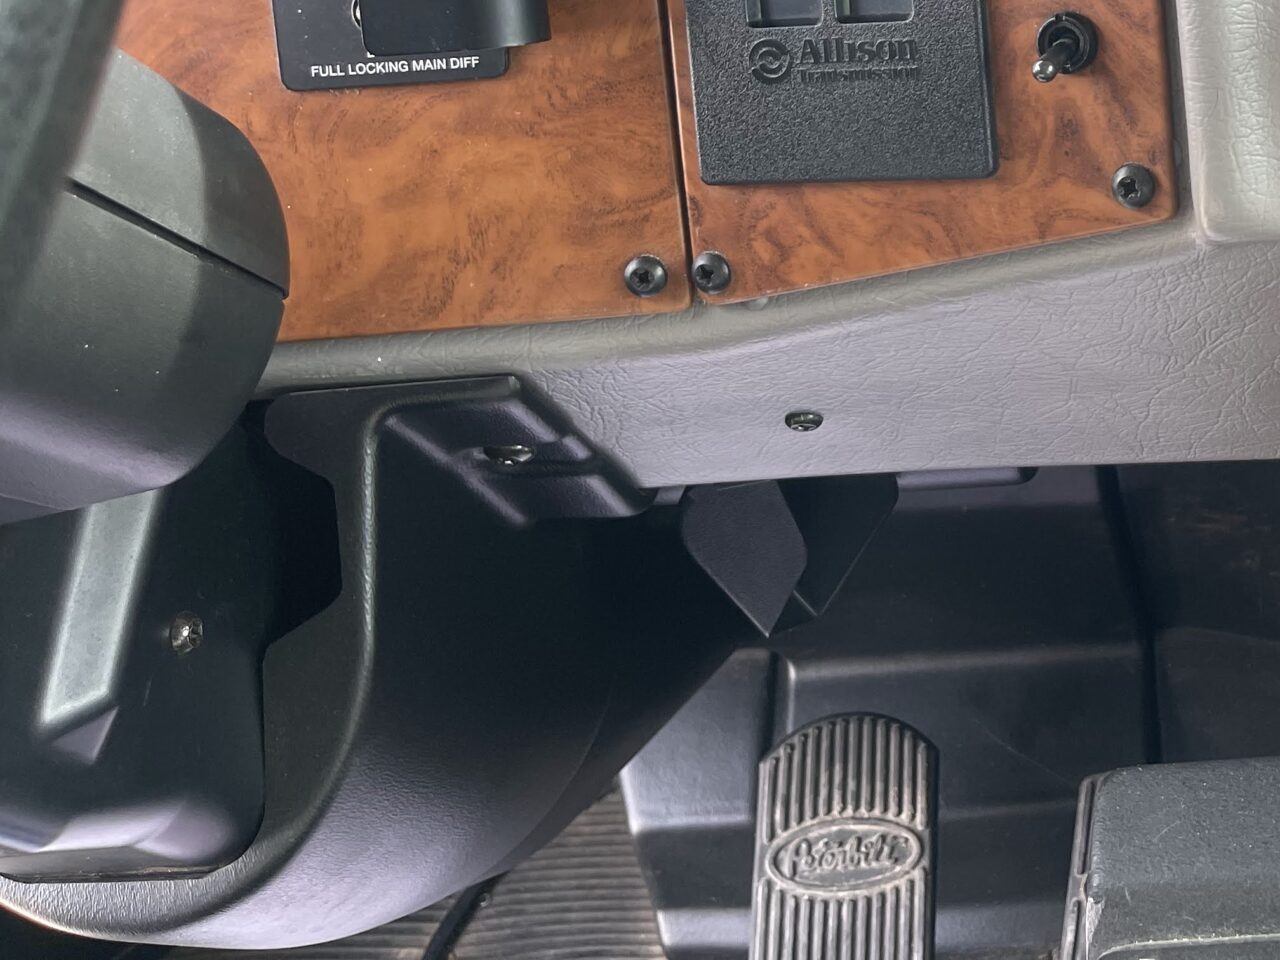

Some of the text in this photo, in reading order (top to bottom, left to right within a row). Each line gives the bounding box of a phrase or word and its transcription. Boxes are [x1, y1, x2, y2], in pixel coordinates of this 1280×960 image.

[311, 56, 480, 77] FULL LOCKING MAIN DIFF
